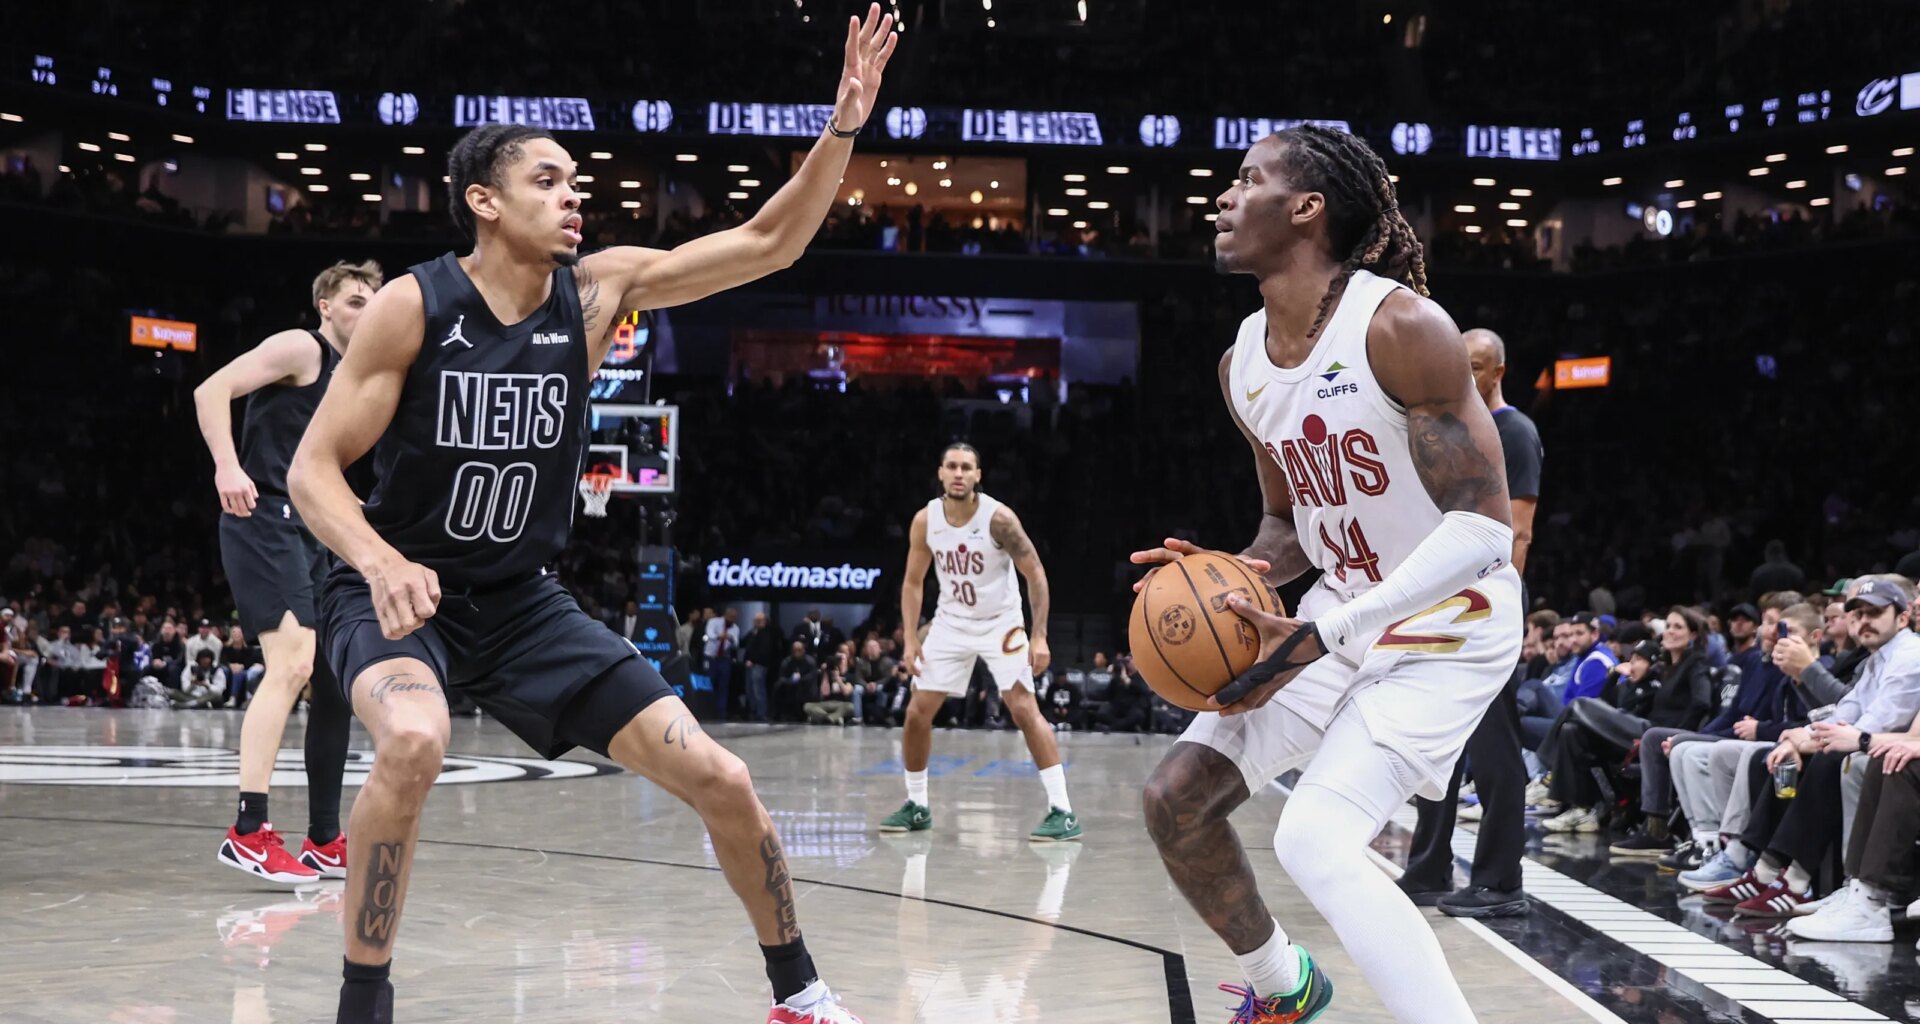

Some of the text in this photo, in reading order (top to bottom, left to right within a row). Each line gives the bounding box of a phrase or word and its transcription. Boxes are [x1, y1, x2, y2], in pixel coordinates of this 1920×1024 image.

[436, 370, 568, 450] NETS
[1317, 383, 1358, 399] CLIFFS
[445, 461, 537, 543] 00
[707, 558, 881, 589] ticketmaster
[936, 549, 984, 575] CAVS
[1319, 516, 1383, 584] 14
[950, 580, 977, 607] 20
[363, 843, 401, 941] NOW
